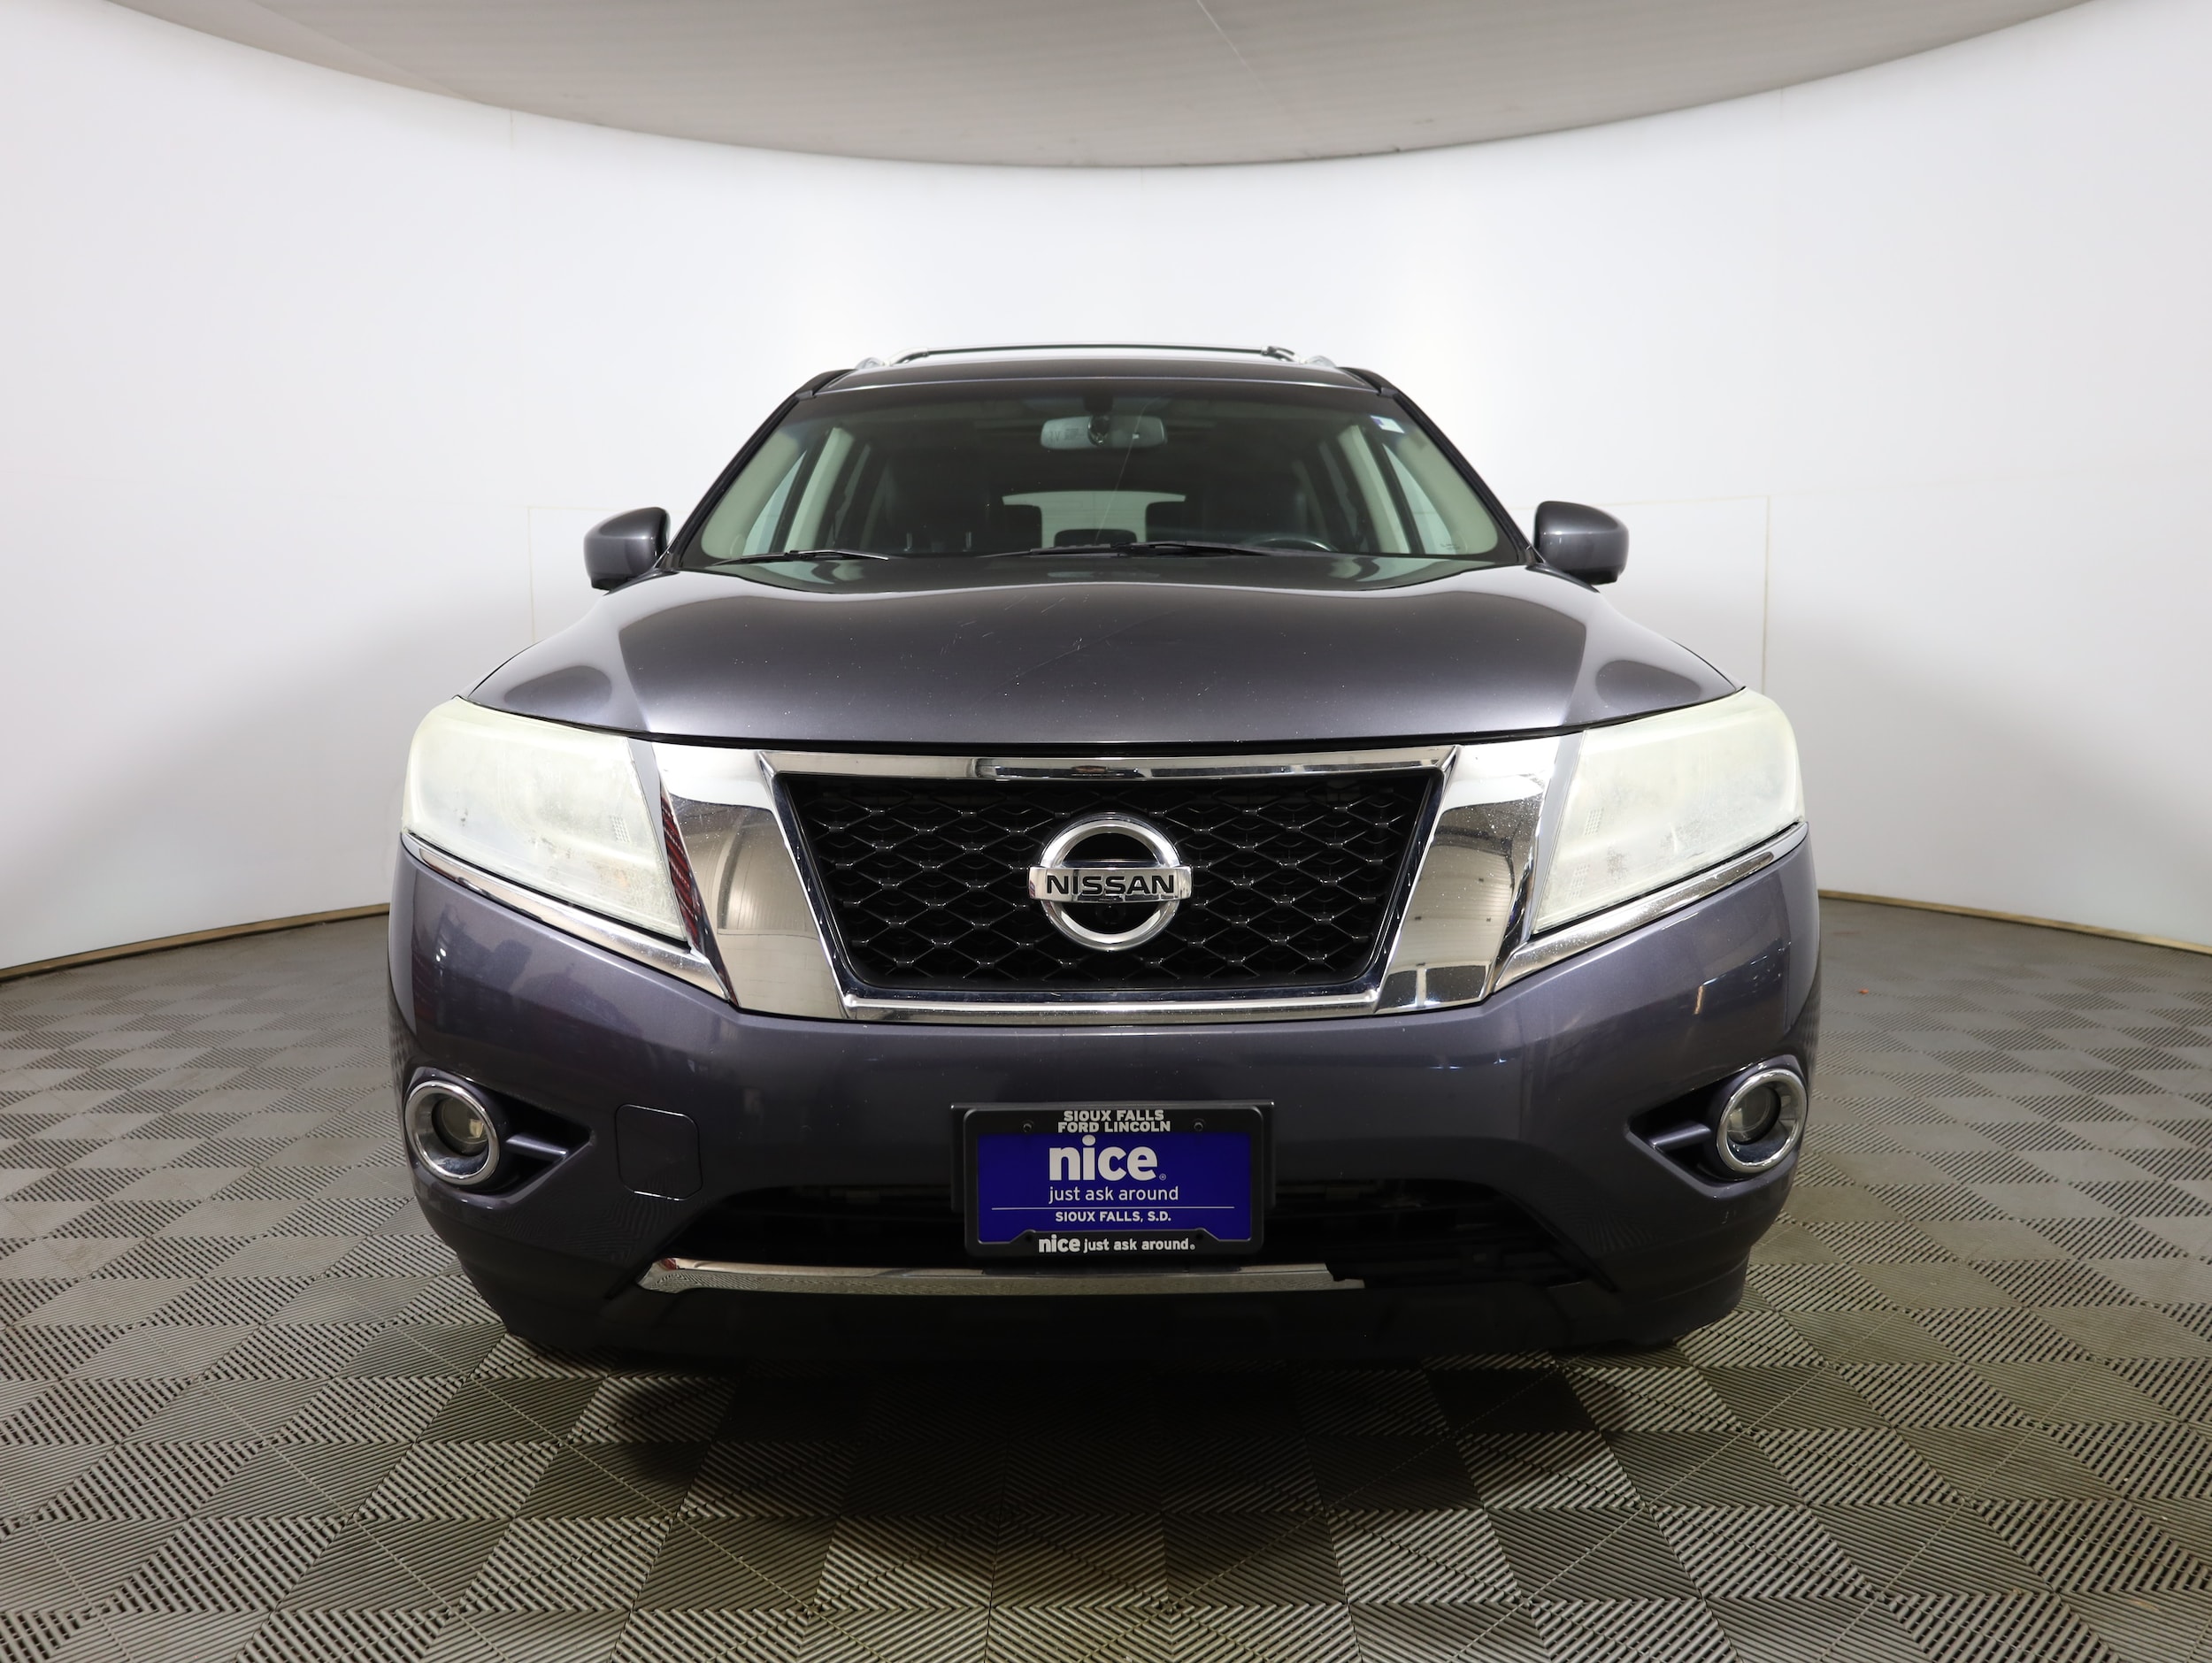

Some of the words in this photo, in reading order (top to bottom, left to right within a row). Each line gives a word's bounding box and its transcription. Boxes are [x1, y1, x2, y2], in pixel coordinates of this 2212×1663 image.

[1047, 875, 1174, 894] NISSAN
[1064, 1110, 1111, 1122] SIOUX
[1116, 1109, 1164, 1121] FALLS
[1057, 1122, 1099, 1133] FORD
[1104, 1121, 1171, 1132] LINCOLN
[1048, 1186, 1080, 1204] just
[1085, 1186, 1114, 1200] ask
[1118, 1186, 1179, 1201] around
[1055, 1211, 1095, 1222] SIOUX
[1099, 1211, 1143, 1222] FALLS,
[1148, 1211, 1171, 1222] S.D.
[1038, 1234, 1080, 1253] nice
[1083, 1238, 1110, 1253] just
[1113, 1238, 1137, 1251] ask
